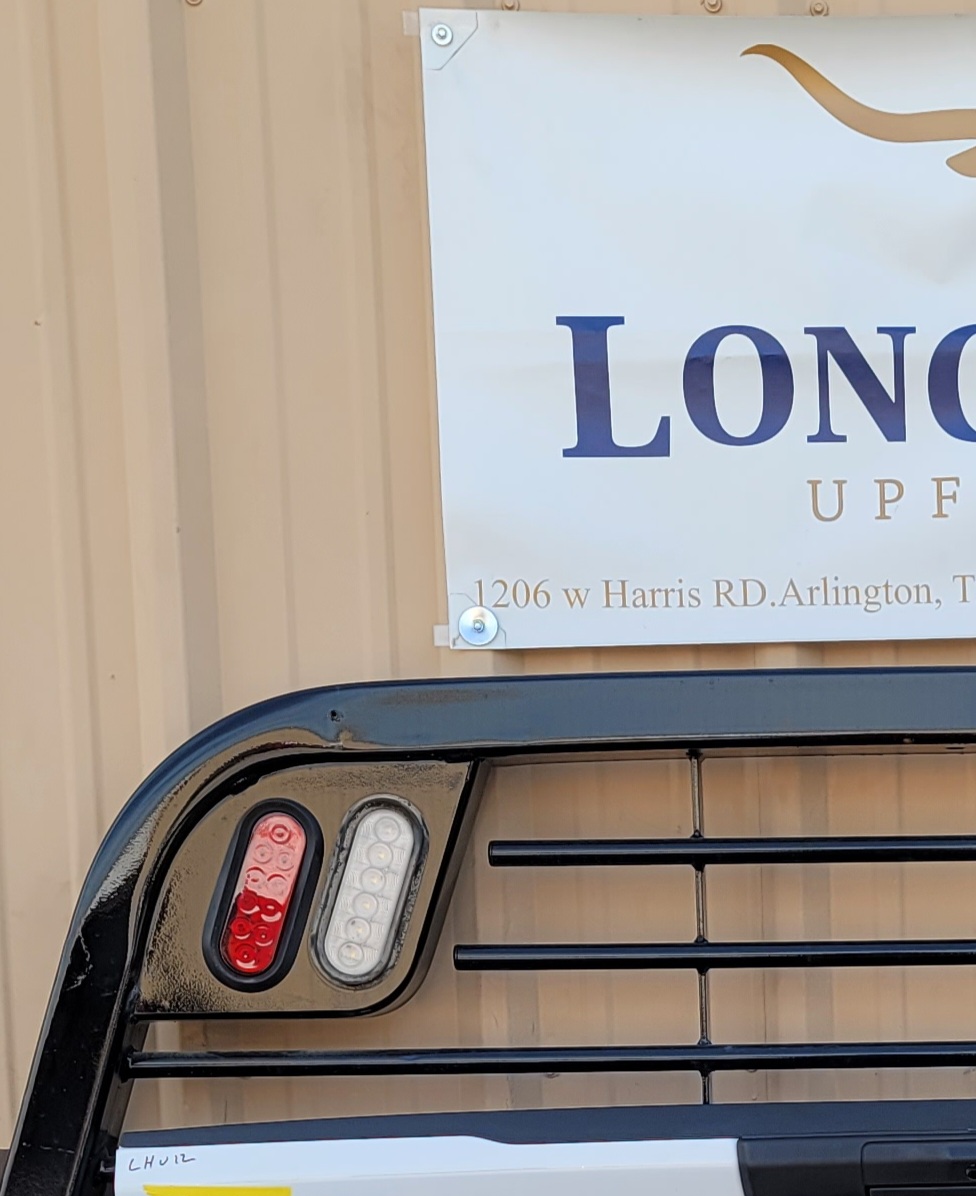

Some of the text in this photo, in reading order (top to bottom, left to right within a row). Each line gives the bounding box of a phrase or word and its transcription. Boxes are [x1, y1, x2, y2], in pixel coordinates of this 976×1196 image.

[474, 578, 551, 609] 1206
[562, 587, 591, 609] w
[601, 577, 701, 609] Harris
